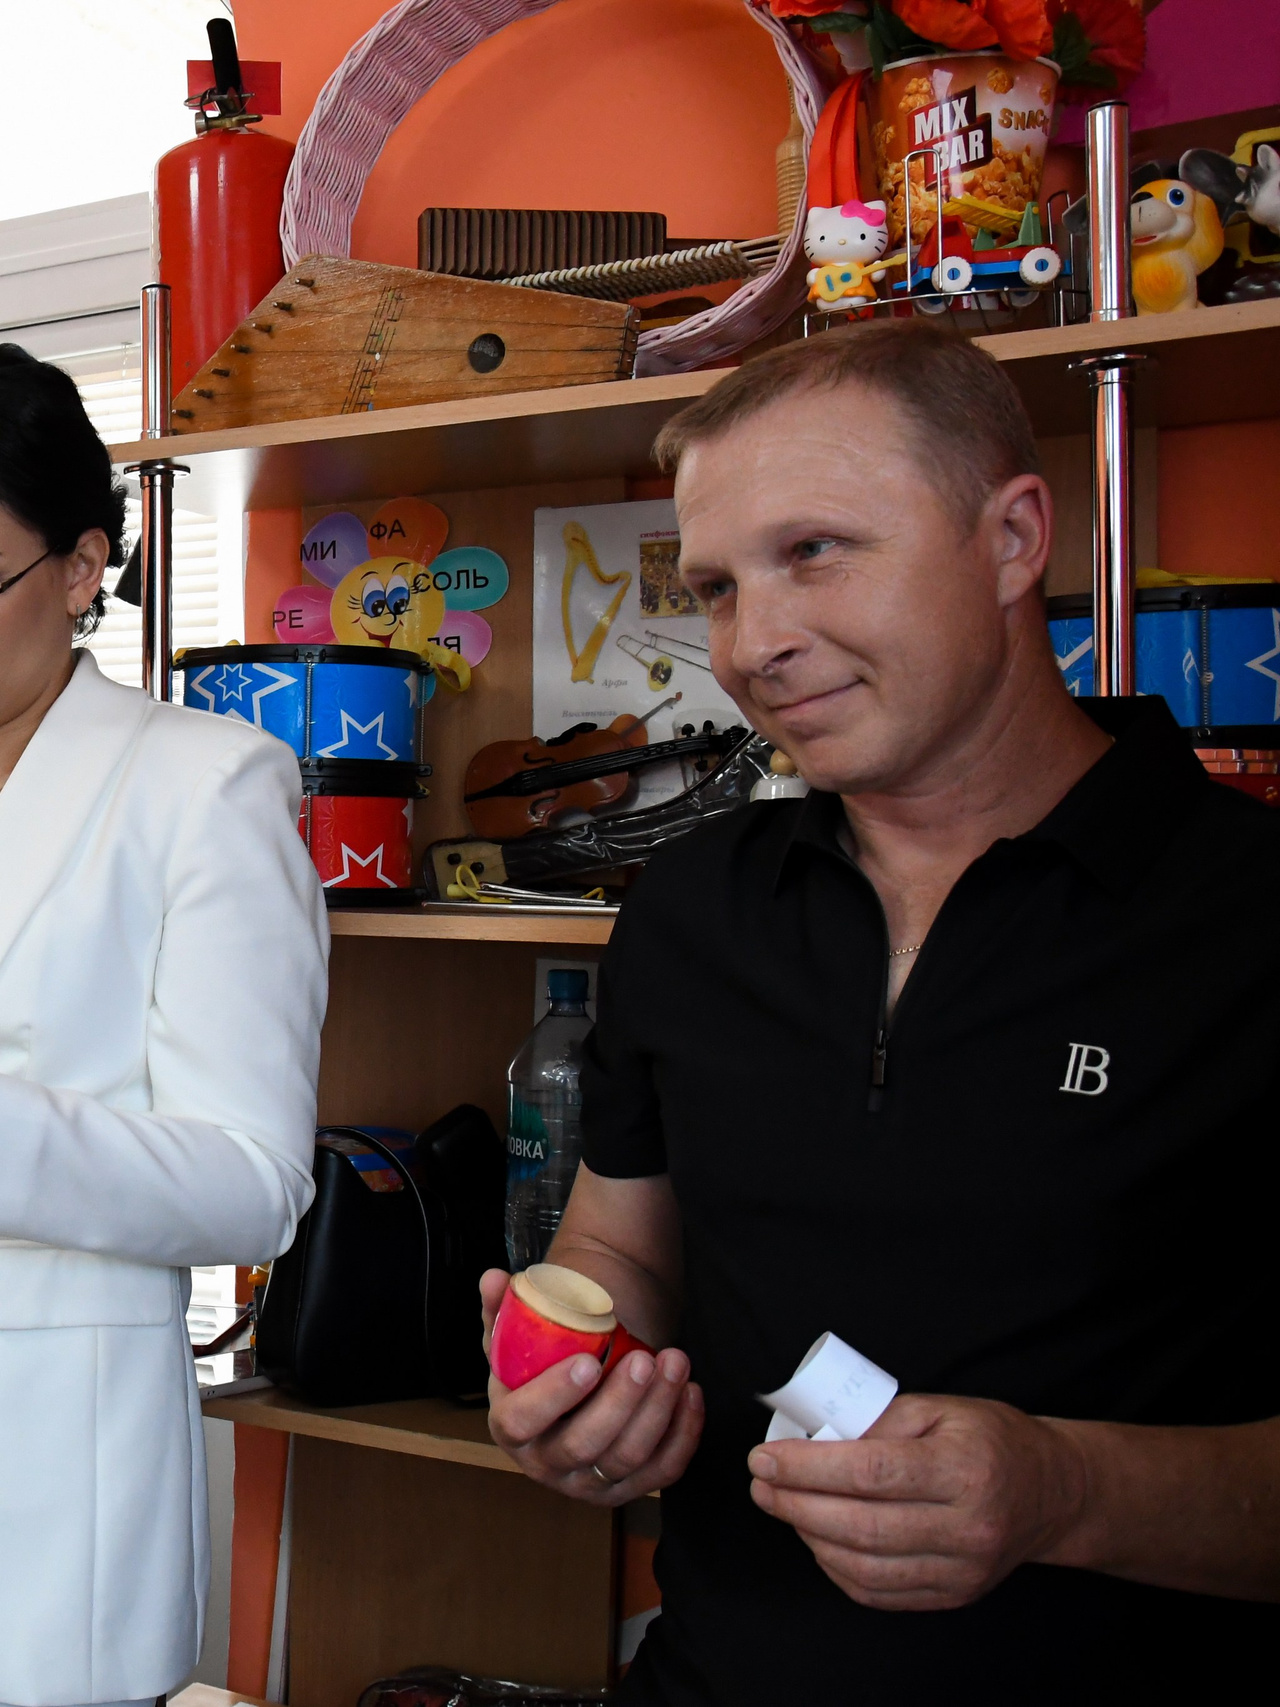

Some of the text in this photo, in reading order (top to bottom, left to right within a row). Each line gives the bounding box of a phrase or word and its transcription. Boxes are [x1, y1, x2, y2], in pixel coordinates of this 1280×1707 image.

[914, 97, 969, 145] MIX
[932, 129, 985, 175] BAR
[370, 519, 406, 540] ФА
[300, 540, 337, 562] МИ
[413, 569, 489, 592] СОЛЬ
[272, 609, 304, 629] РЕ
[507, 1135, 544, 1160] ОВКА
